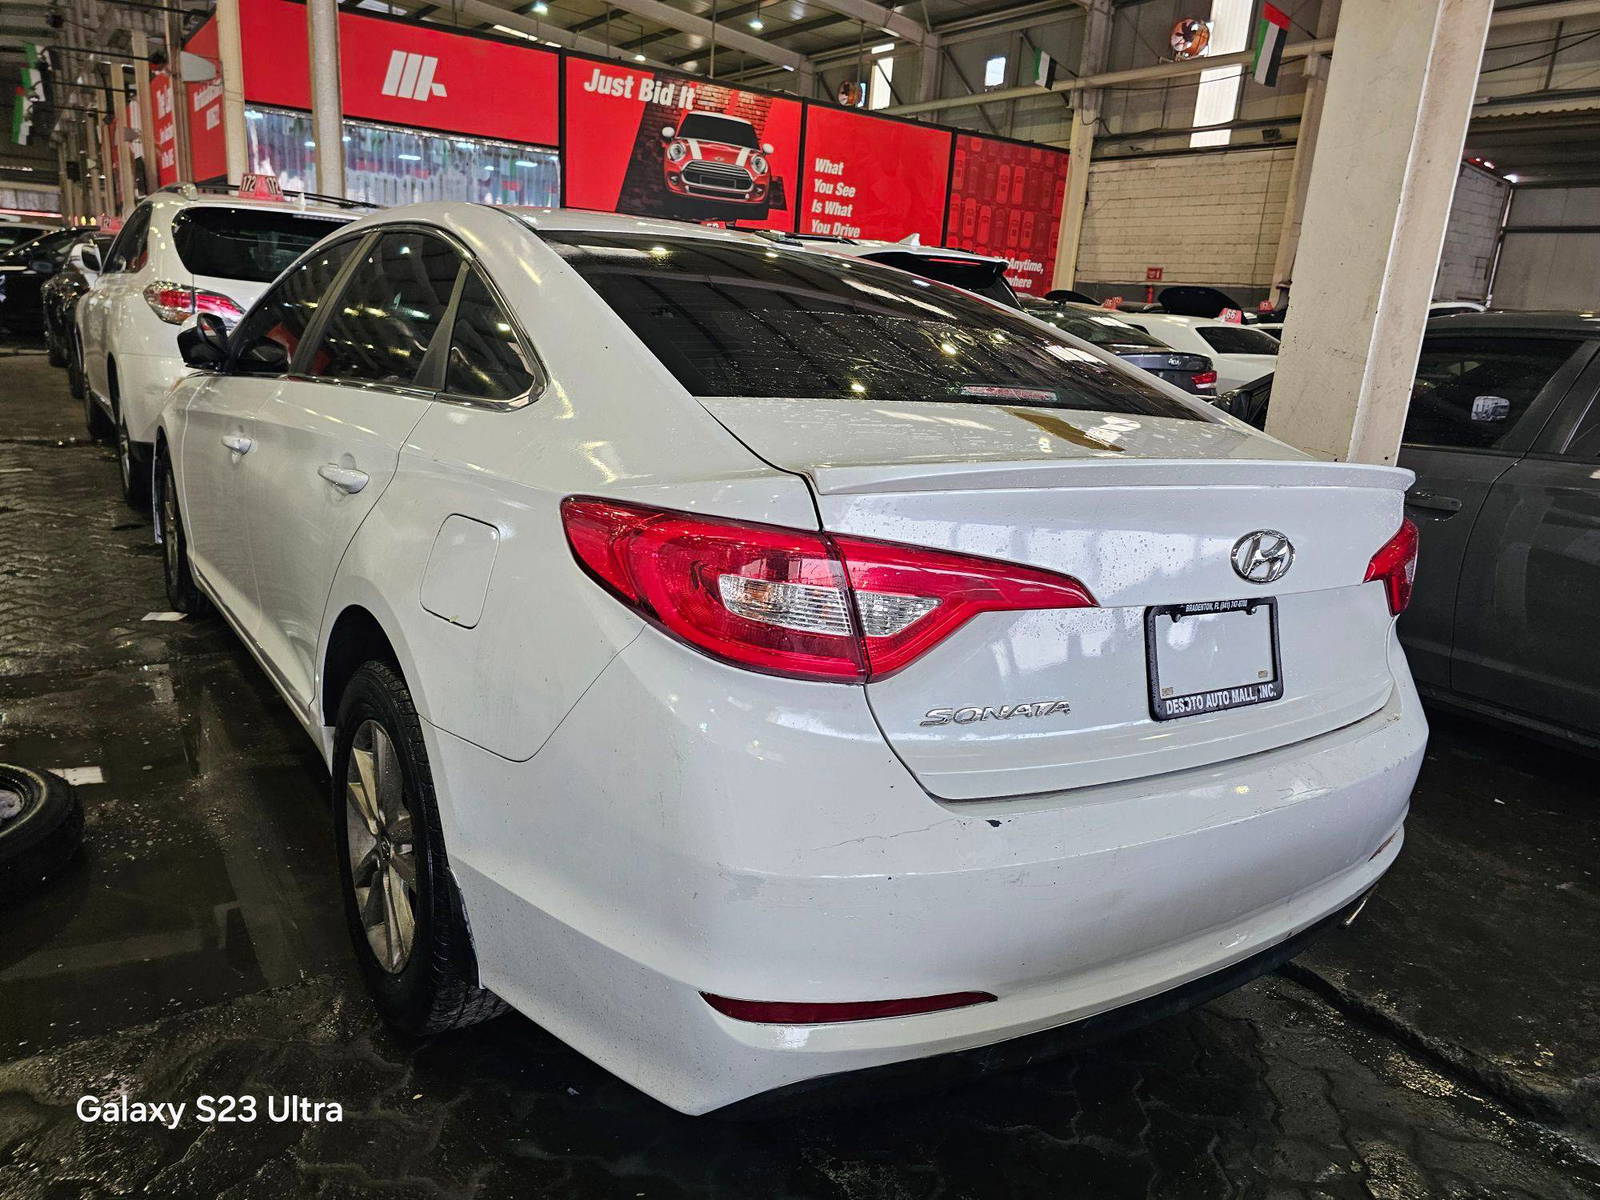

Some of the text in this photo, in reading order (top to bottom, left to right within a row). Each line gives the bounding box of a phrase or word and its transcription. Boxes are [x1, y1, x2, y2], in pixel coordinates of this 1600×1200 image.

[584, 68, 696, 110] Just Bid It
[815, 157, 845, 176] What
[241, 175, 256, 192] 172
[813, 178, 856, 198] You See
[811, 199, 853, 218] Is What
[811, 219, 861, 238] You Drive
[1007, 257, 1044, 275] Anytime,
[1006, 275, 1032, 289] where
[1206, 690, 1230, 708] AUTO
[1231, 687, 1258, 703] MALL,
[1259, 683, 1277, 699] INC.
[919, 700, 1071, 727] SONATA
